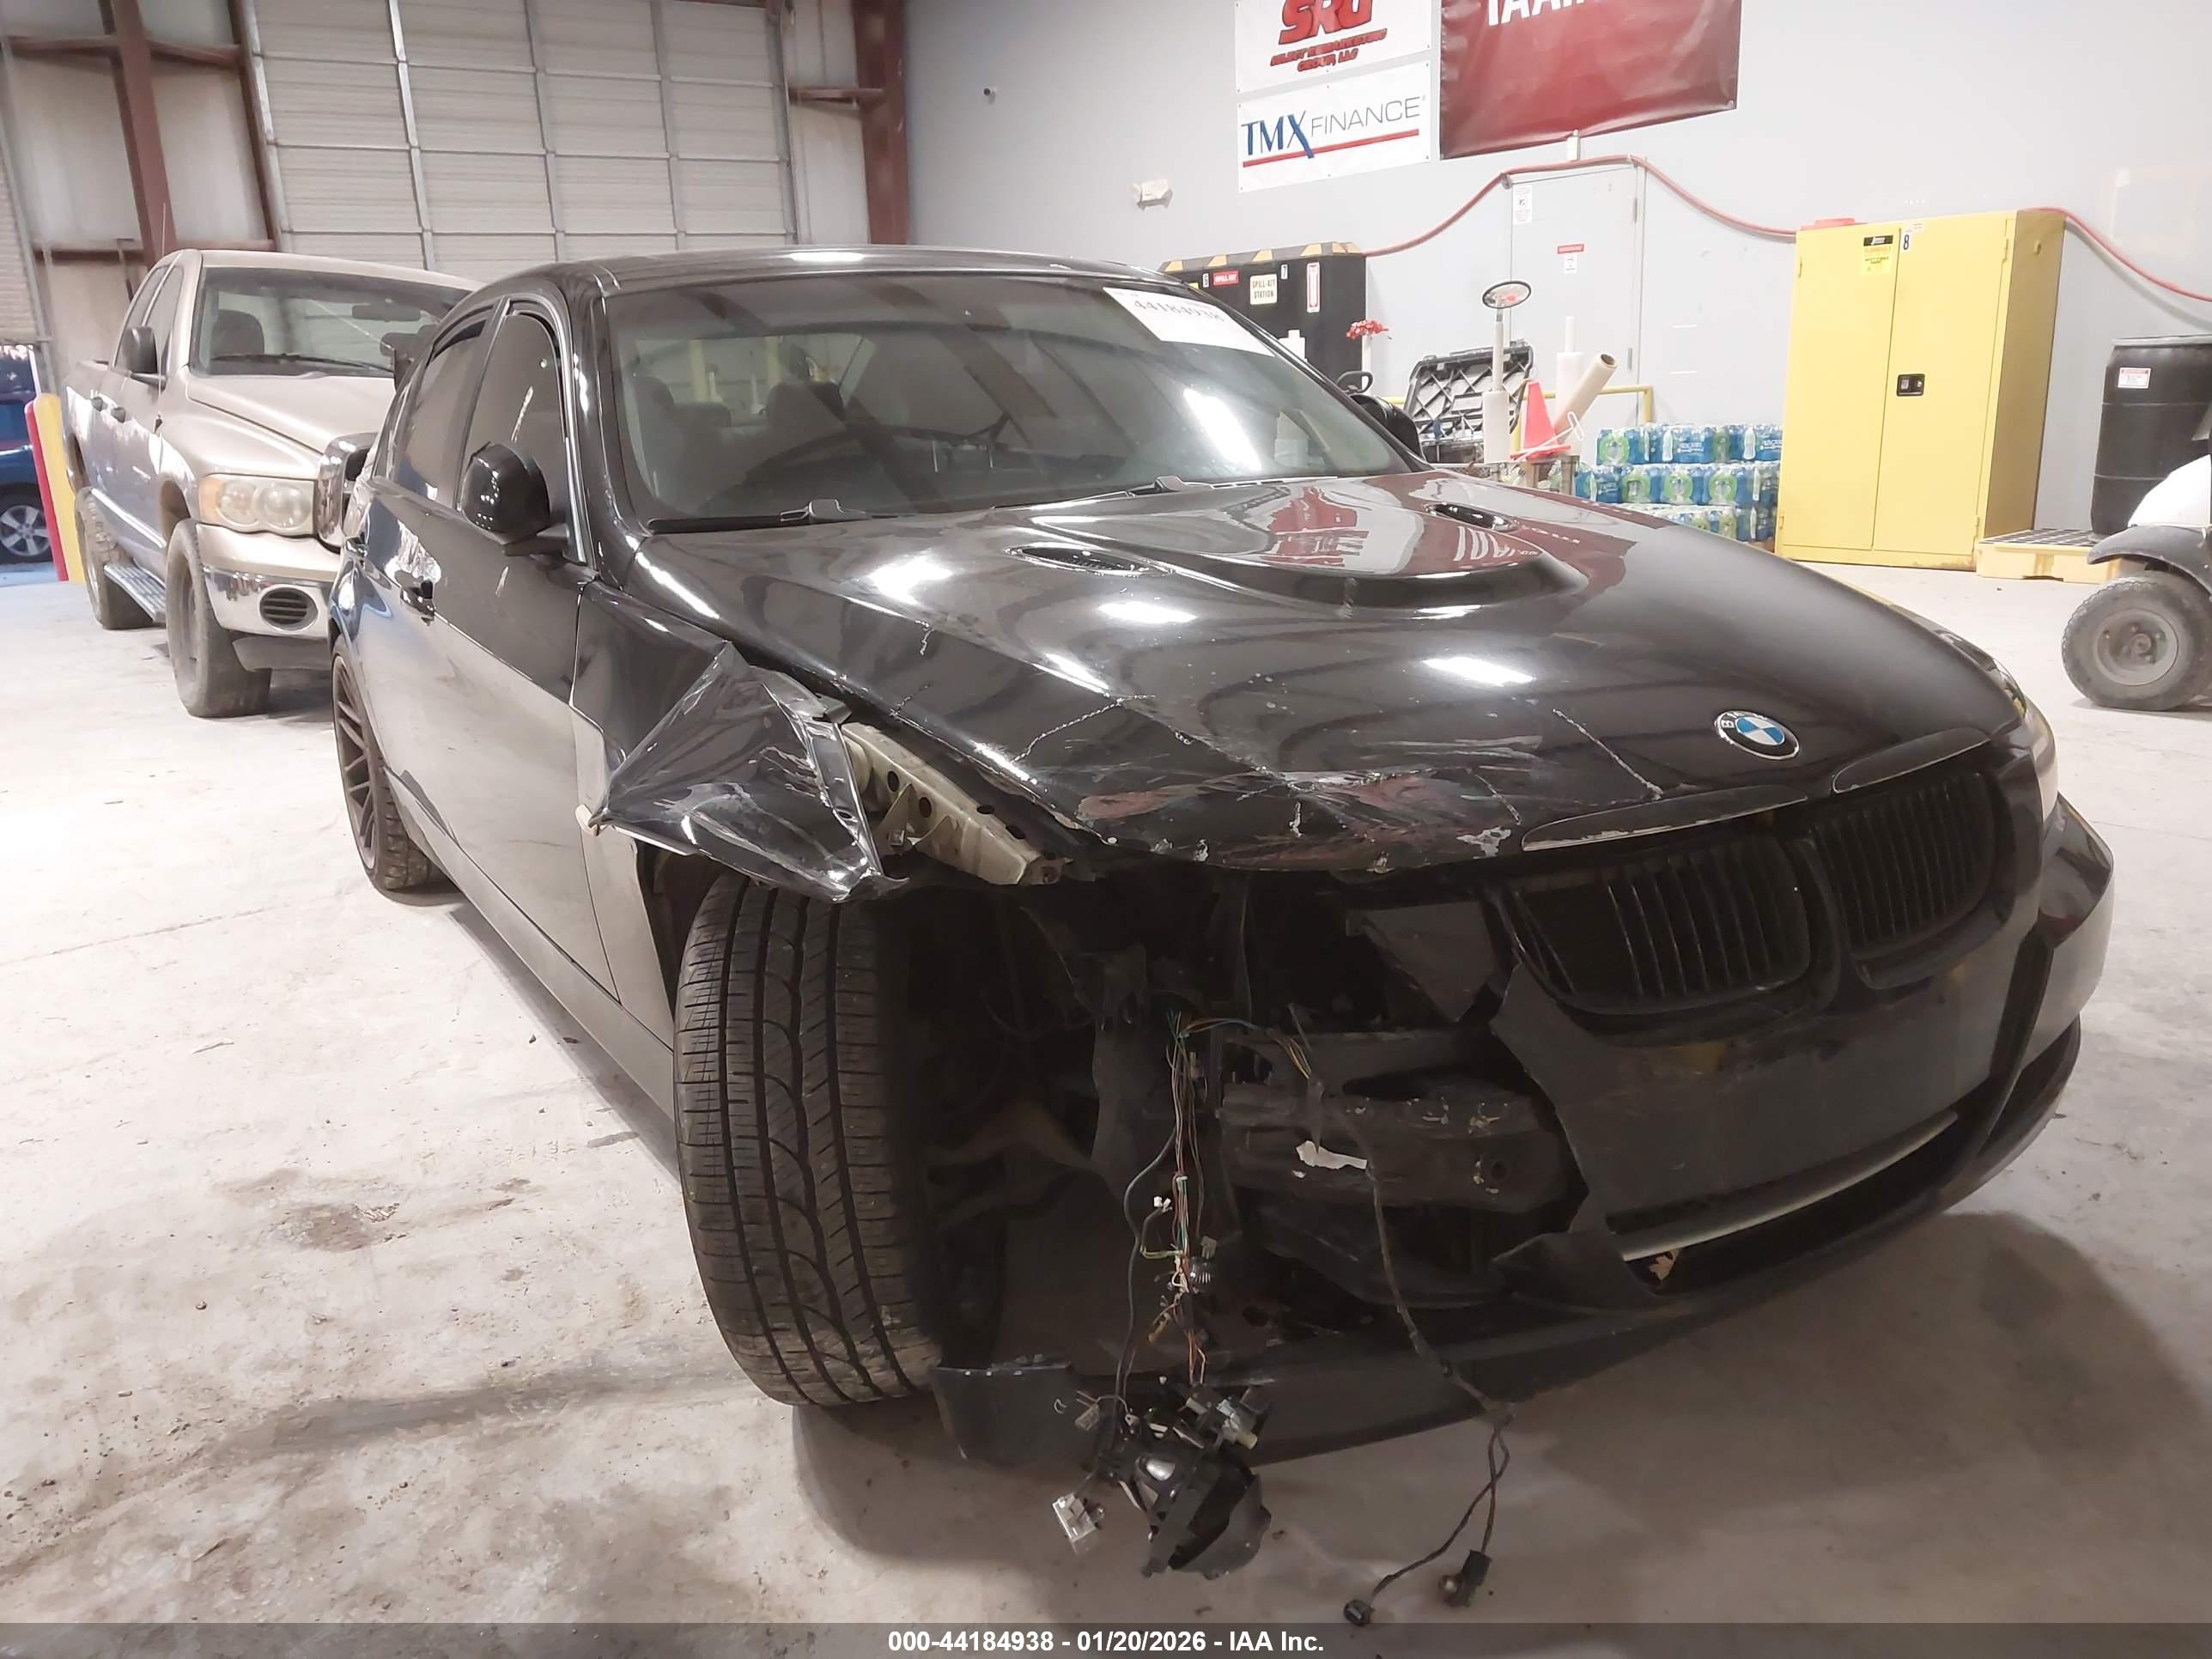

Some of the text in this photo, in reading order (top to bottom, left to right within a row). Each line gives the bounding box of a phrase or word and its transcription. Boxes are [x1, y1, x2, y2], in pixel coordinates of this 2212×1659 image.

[1241, 96, 1420, 159] TMX FINANCE
[1903, 234, 1910, 250] 8
[1282, 265, 1287, 278] 7
[1254, 290, 1274, 299] STATION
